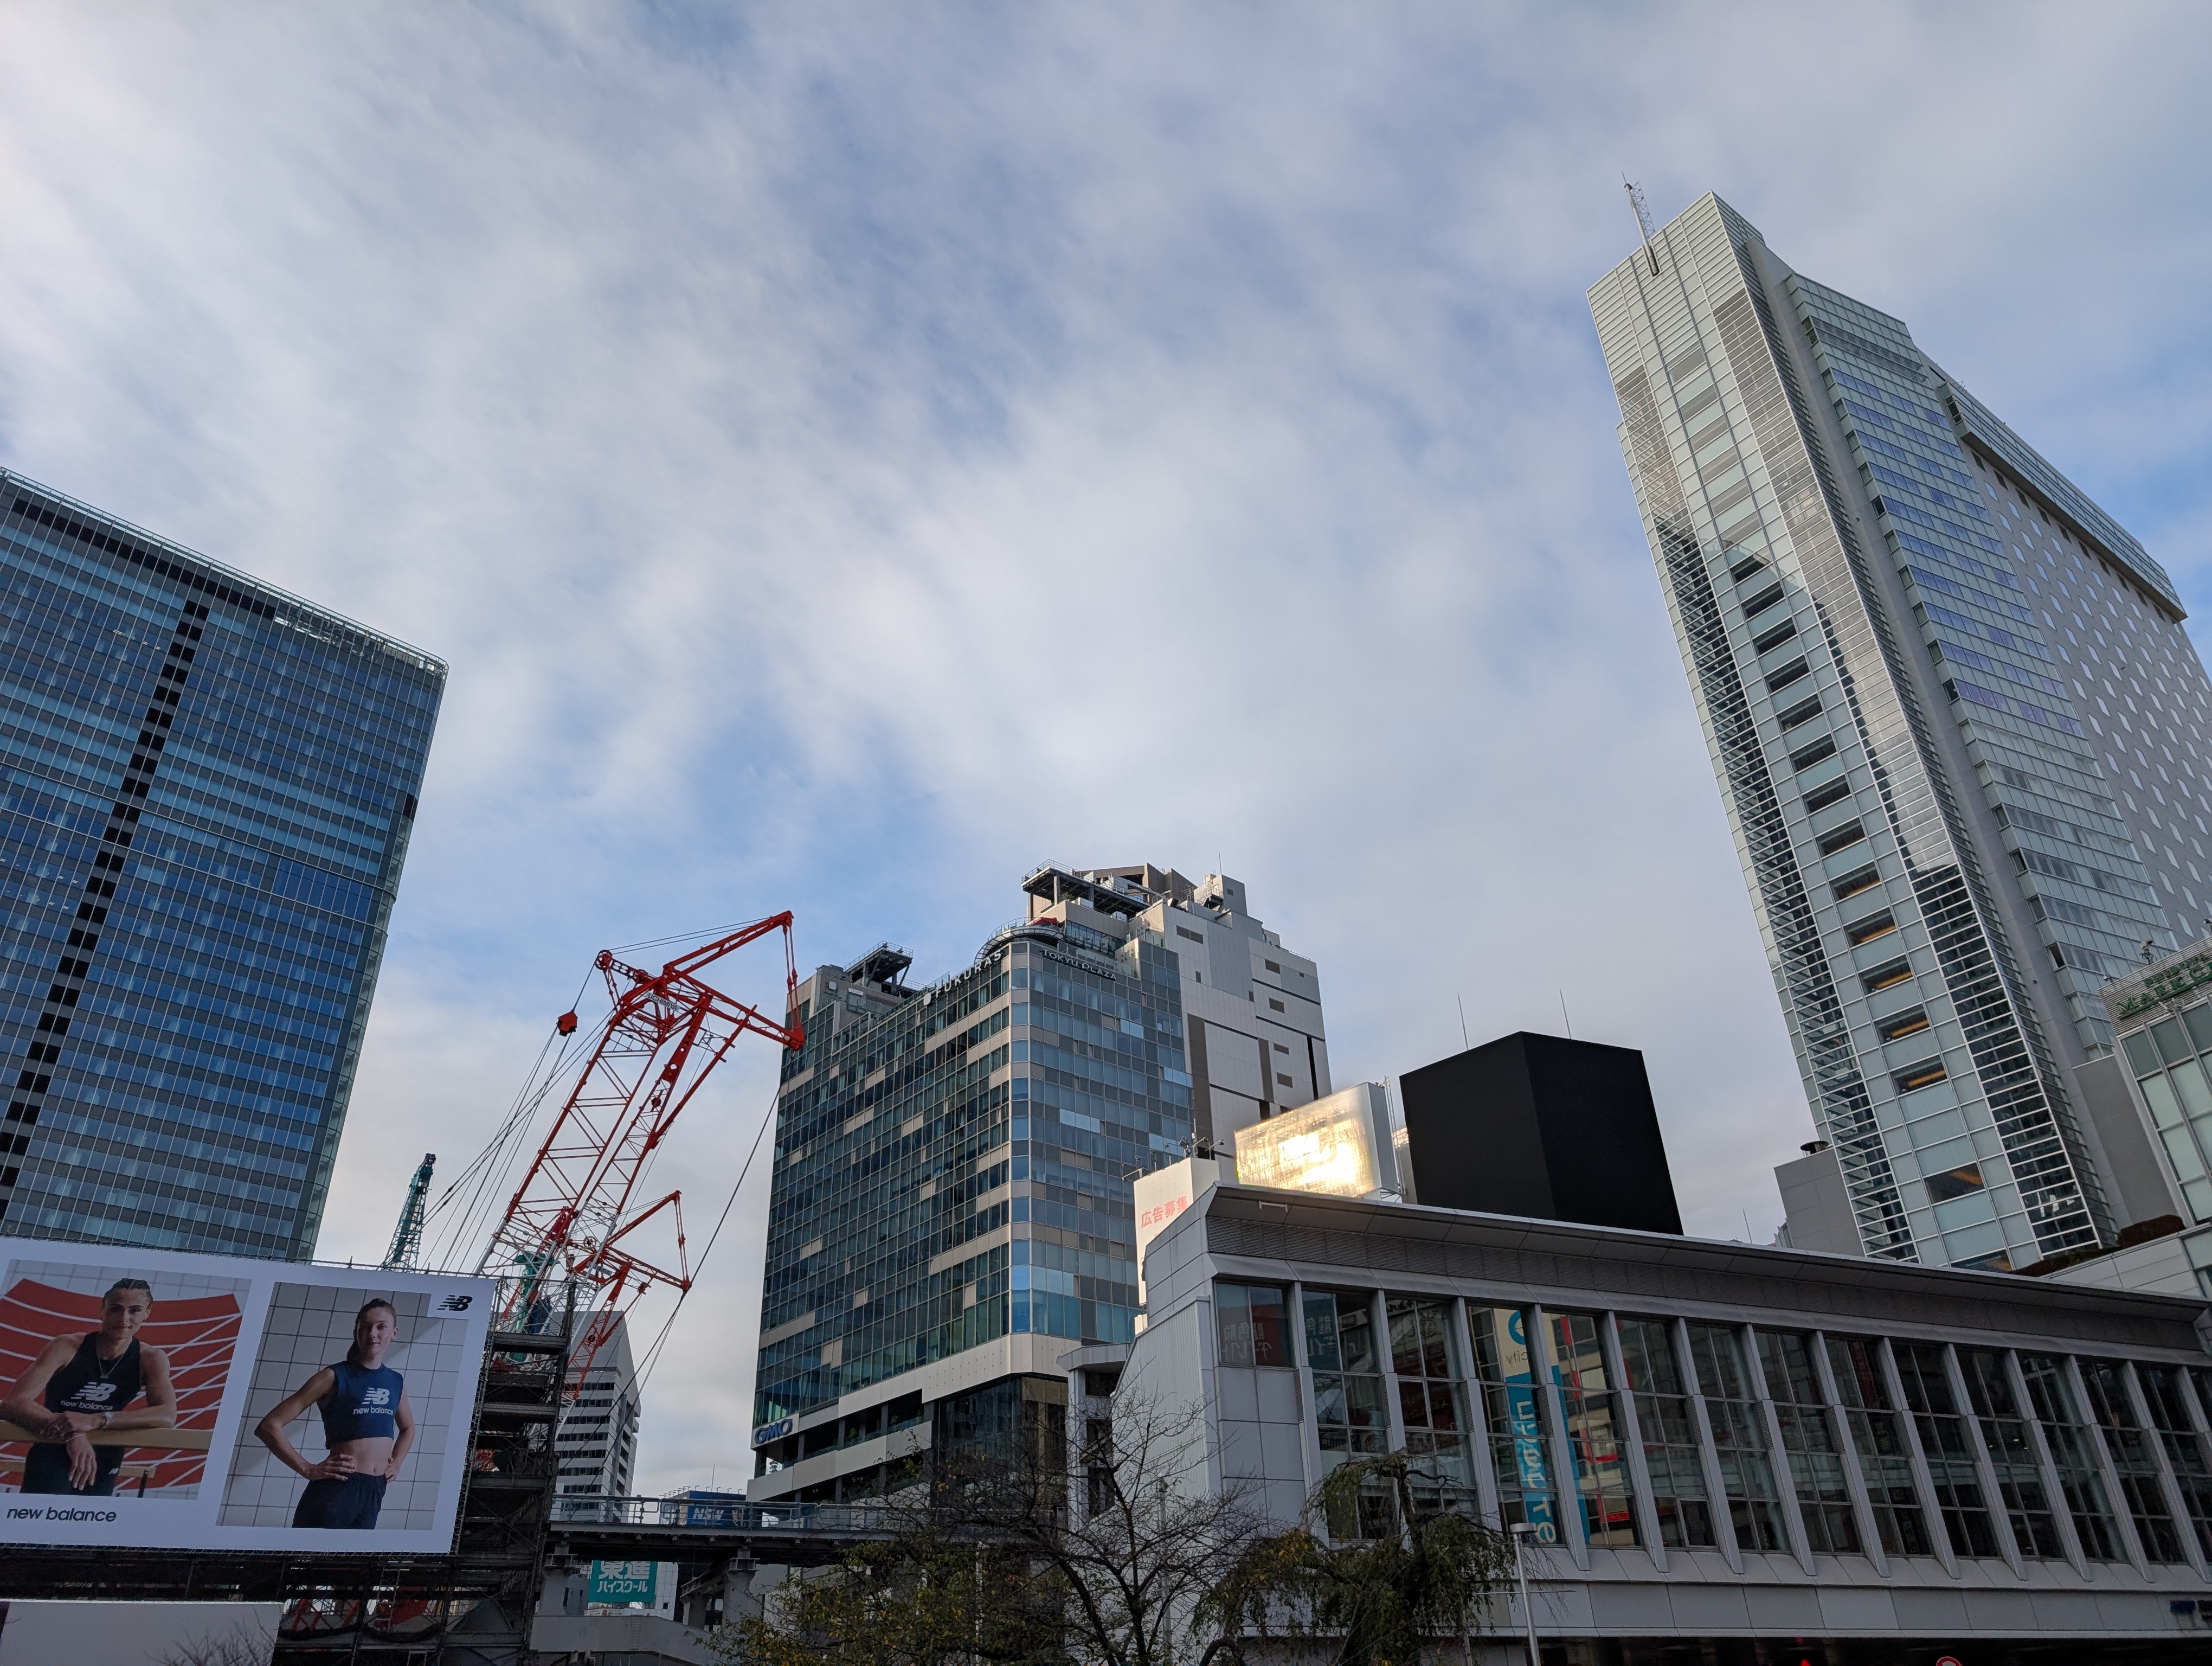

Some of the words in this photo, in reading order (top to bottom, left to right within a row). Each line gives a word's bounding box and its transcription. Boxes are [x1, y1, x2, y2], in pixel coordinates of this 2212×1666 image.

[1042, 948, 1078, 966] TOKYU
[1082, 963, 1117, 980] PLAZA
[936, 949, 1002, 998] FUKURAS
[647, 993, 677, 1011] UCHIMIYA
[2117, 976, 2185, 1015] MARK
[1141, 1195, 1188, 1228] 広告募集
[79, 1401, 113, 1411] balance
[370, 1406, 394, 1416] balance
[754, 1418, 793, 1444] GMO
[6, 1508, 43, 1520] new
[46, 1507, 117, 1522] balance
[599, 1561, 650, 1579] 東進
[596, 1580, 648, 1593] ハイスクール
